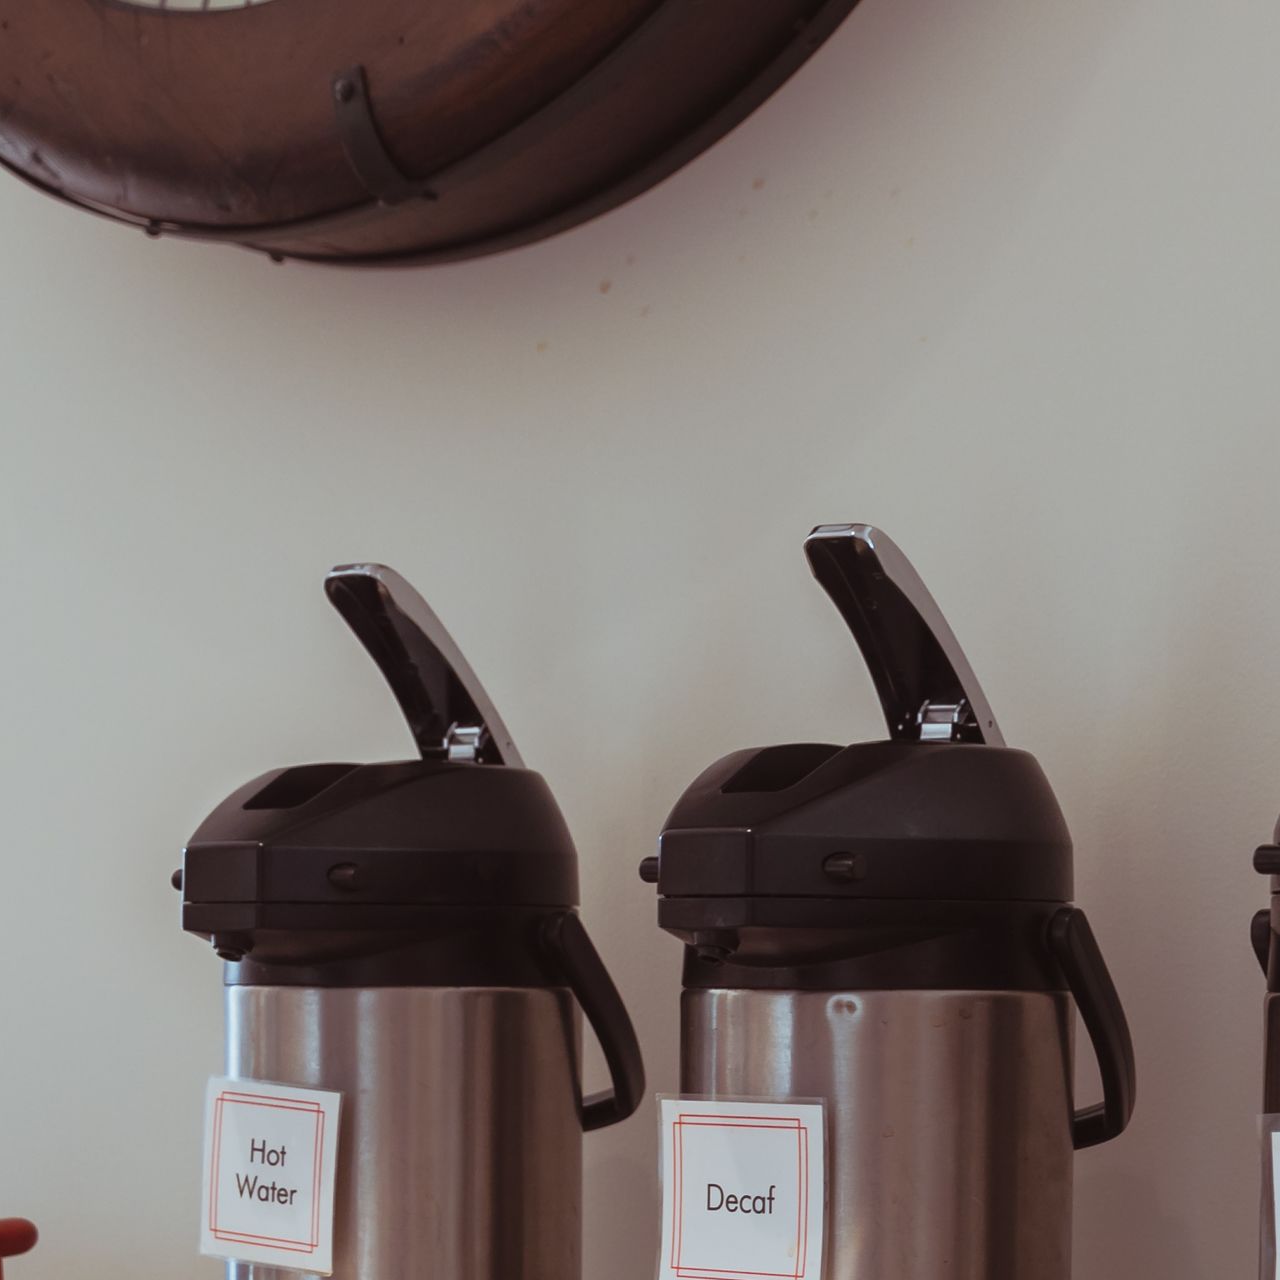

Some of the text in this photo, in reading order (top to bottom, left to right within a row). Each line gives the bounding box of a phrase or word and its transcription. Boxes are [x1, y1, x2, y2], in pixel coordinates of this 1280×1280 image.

[251, 1138, 286, 1167] Hot
[236, 1173, 297, 1205] Water
[706, 1183, 776, 1214] Decaf
